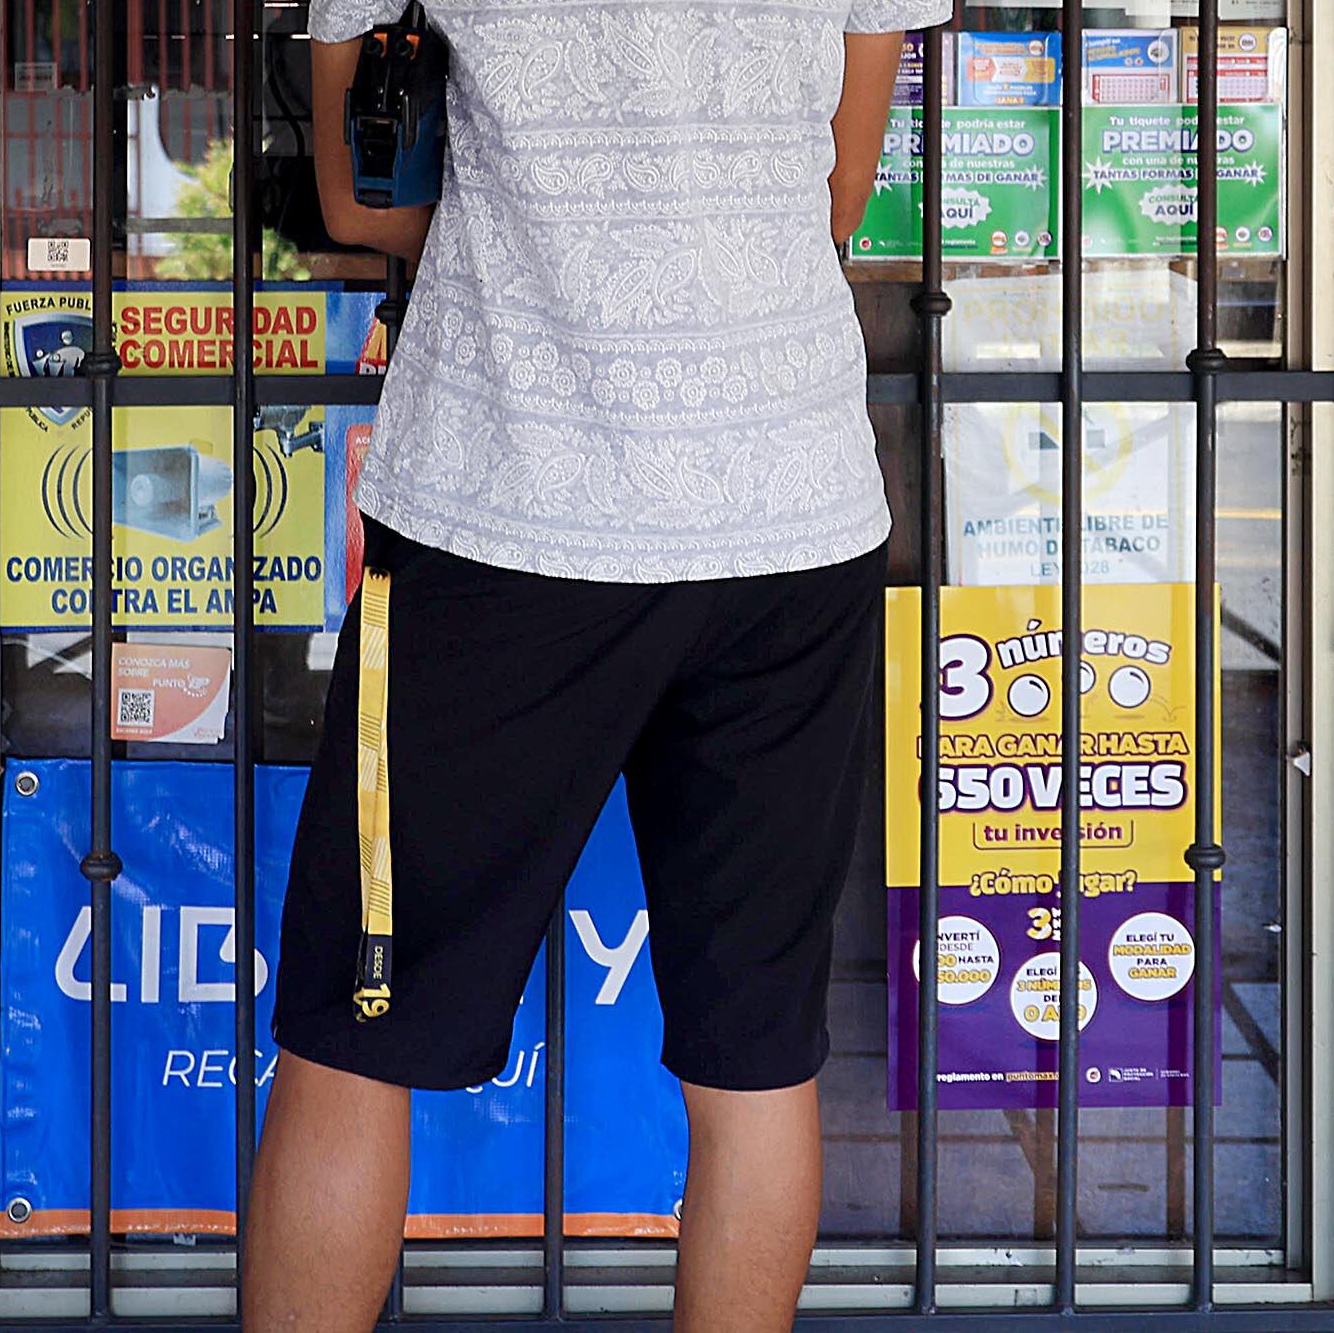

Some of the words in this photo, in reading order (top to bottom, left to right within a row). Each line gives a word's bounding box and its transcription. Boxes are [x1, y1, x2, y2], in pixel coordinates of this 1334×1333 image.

[1109, 116, 1124, 126] Tu
[1129, 116, 1171, 127] tiquete
[882, 132, 1036, 157] PRMIADO
[1093, 169, 1137, 179] TANTAS
[1142, 169, 1193, 179] FORMAS
[1154, 202, 1194, 216] AQUÍ
[6, 297, 56, 316] FUERZA
[58, 297, 93, 312] PUBL
[120, 306, 317, 336] SEGURDAD
[6, 555, 143, 583] COMERIO
[151, 555, 322, 582] ORGANZADO
[51, 588, 159, 615] COTRA
[167, 588, 198, 614] EL
[1098, 731, 1190, 757] HASTA
[983, 824, 1009, 842] tu
[1015, 821, 1123, 842] invesión
[970, 868, 1054, 897] ¿Cómo
[1125, 931, 1158, 942] ELEGÍ
[1159, 934, 1175, 942] TU
[1113, 944, 1192, 956] MODALIDAD
[371, 945, 384, 980] DESDE
[1136, 957, 1168, 966] PARA
[1128, 967, 1177, 979] GANAR
[361, 983, 391, 1018] 19
